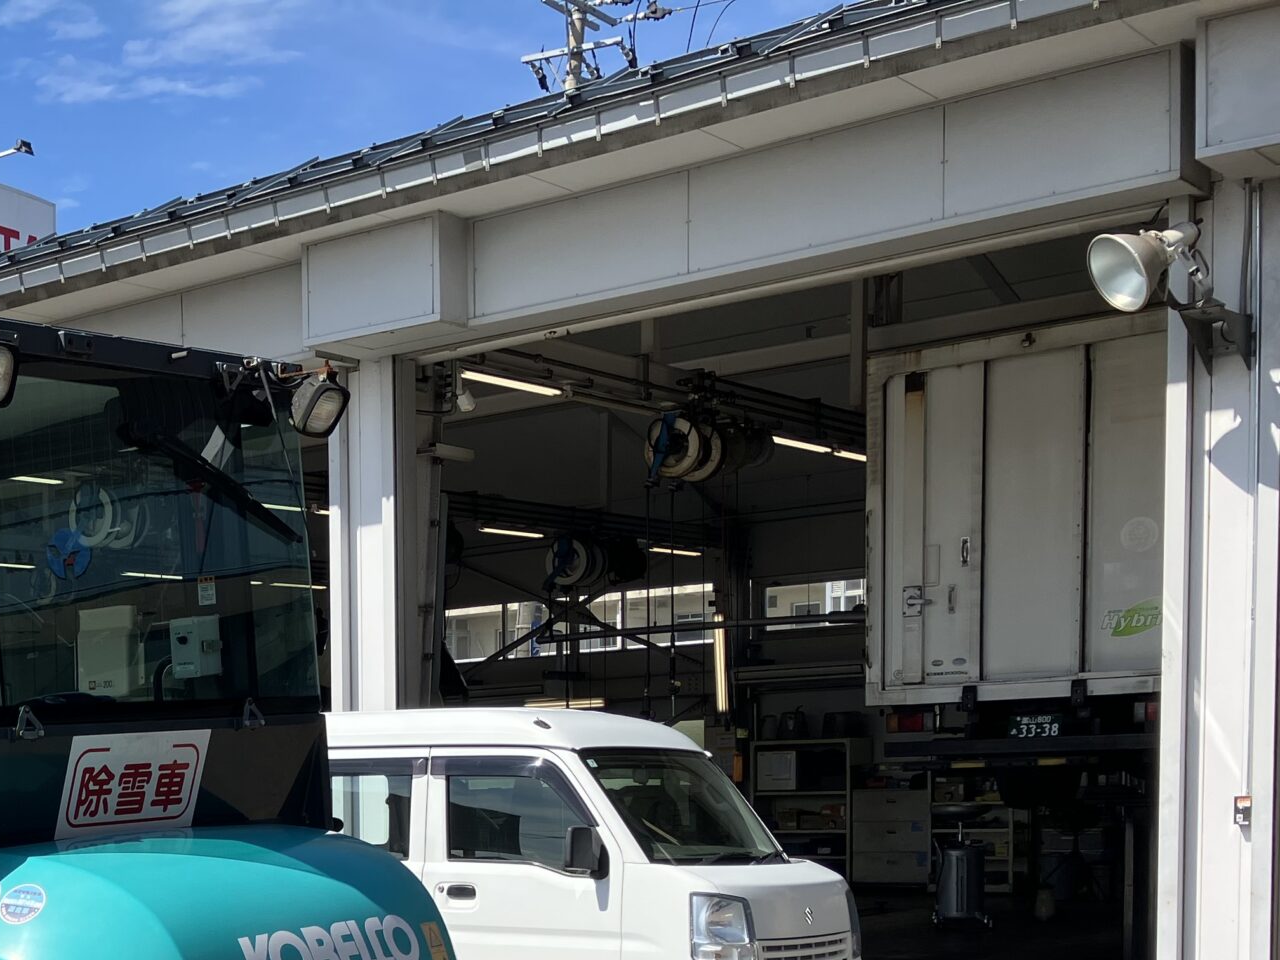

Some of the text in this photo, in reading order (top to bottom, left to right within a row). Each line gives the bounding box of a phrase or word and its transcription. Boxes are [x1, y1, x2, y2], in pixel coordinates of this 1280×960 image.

[1100, 612, 1163, 632] Hybri
[1018, 723, 1059, 738] 33-38
[73, 759, 190, 820] 除雪車
